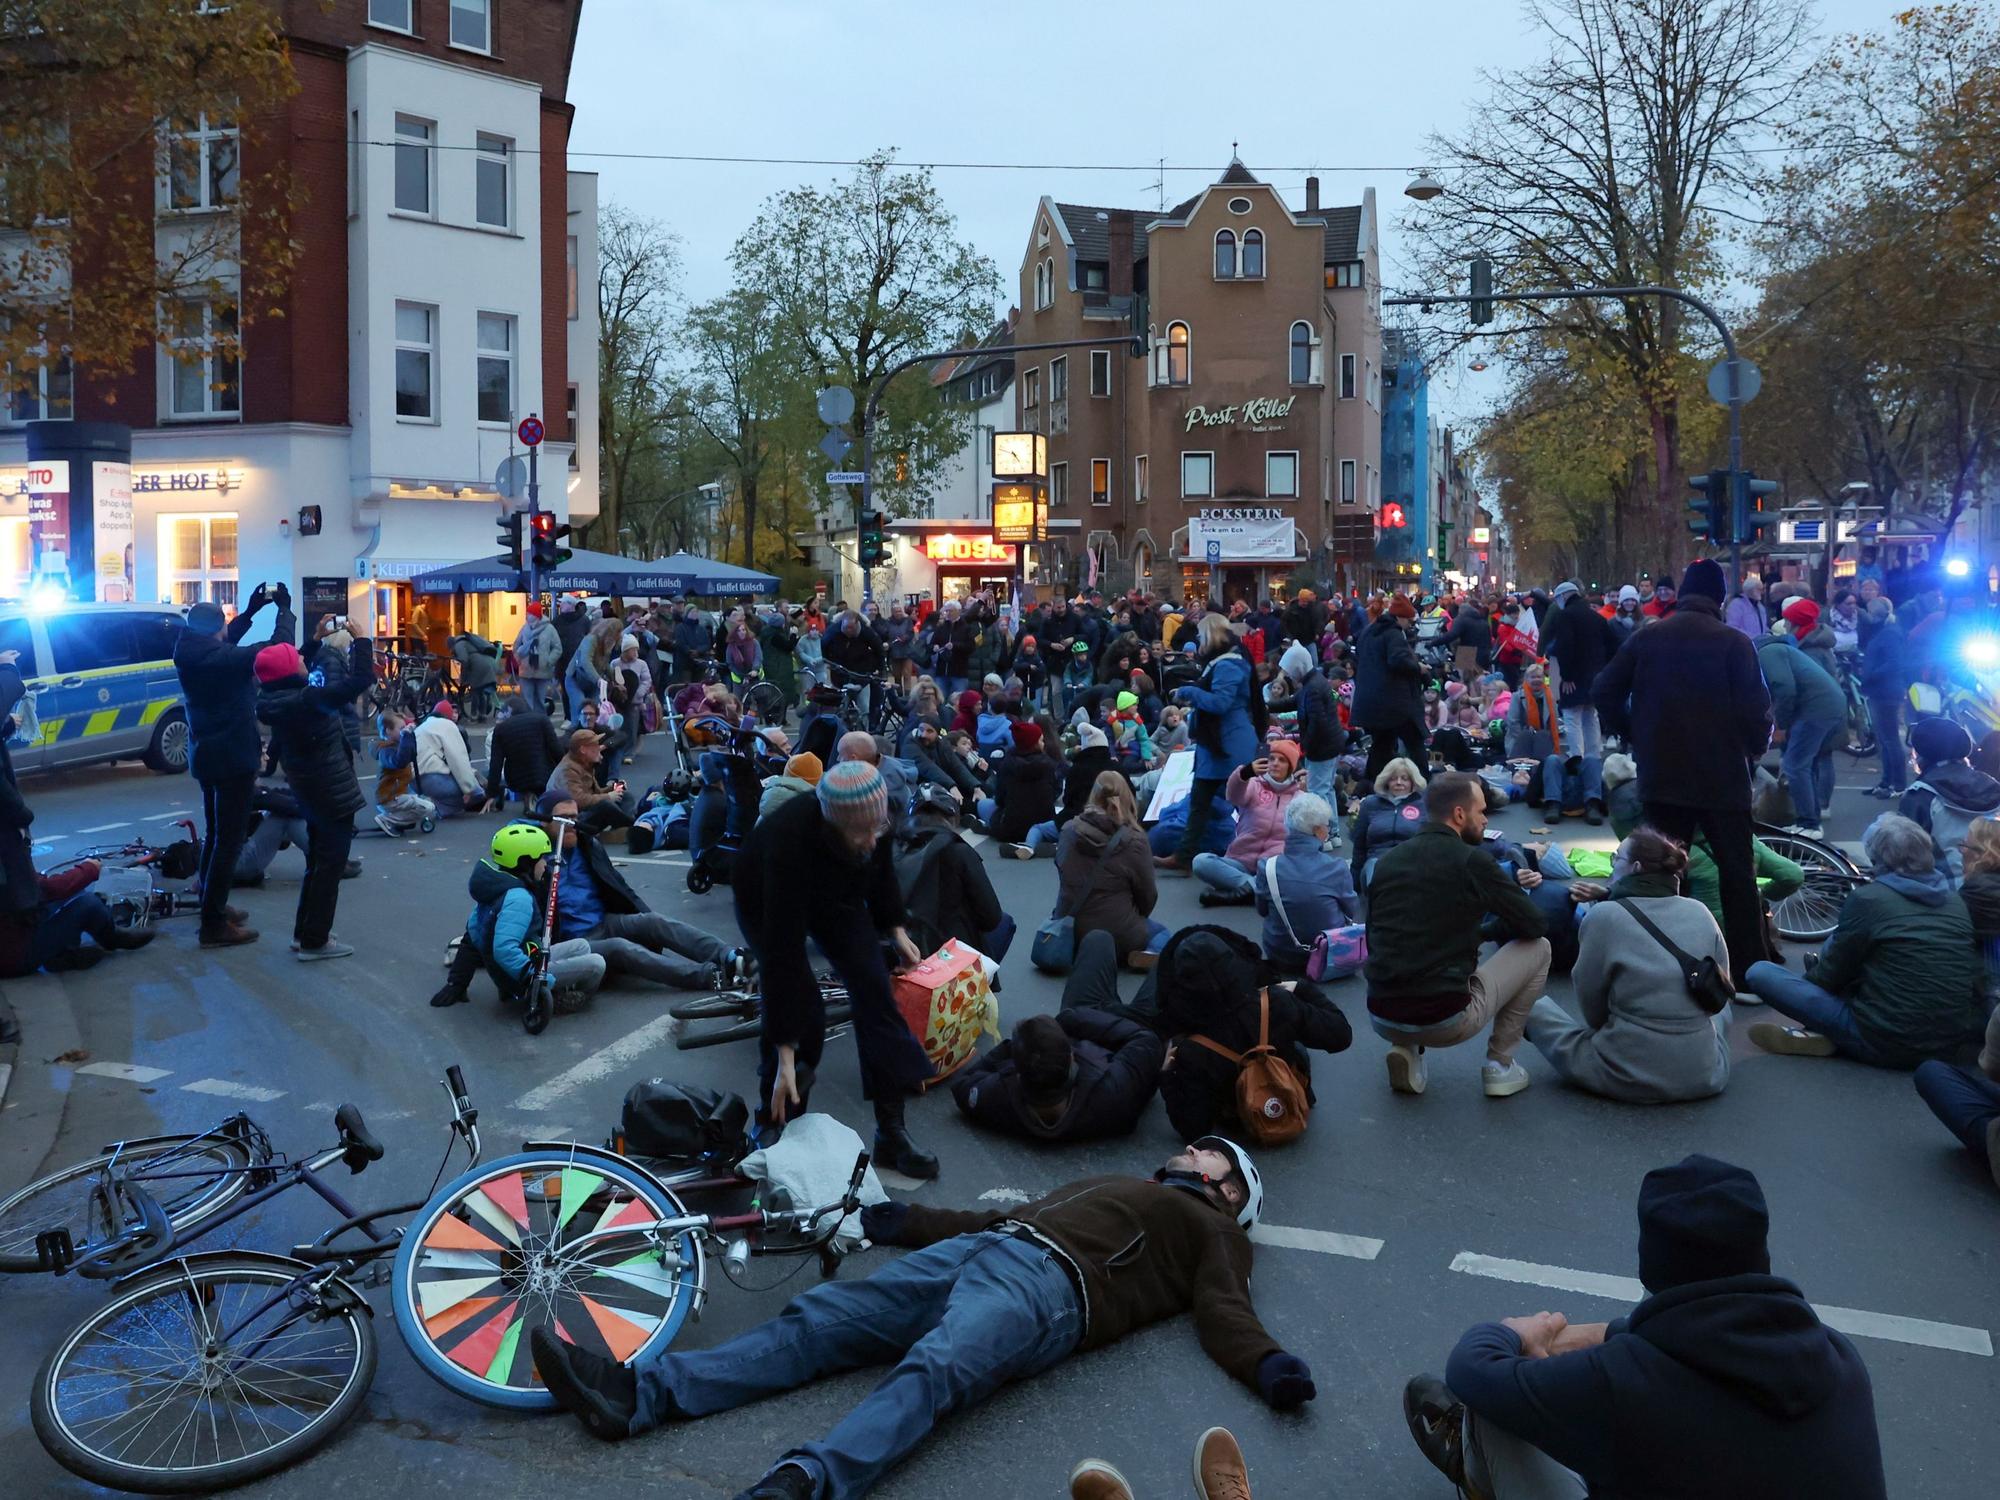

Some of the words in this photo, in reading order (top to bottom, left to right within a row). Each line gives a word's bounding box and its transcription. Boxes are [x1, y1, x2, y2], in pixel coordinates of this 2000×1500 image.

[1242, 395, 1296, 424] Kölle!
[170, 473, 209, 490] HOF
[828, 473, 862, 482] Gottesweg
[1200, 508, 1282, 520] ECKSTEIN
[927, 540, 1009, 559] KIOSK
[549, 577, 571, 588] Gaffel
[572, 577, 599, 589] Kölsch
[636, 577, 657, 588] Gaffel
[657, 577, 681, 589] Kölsch
[716, 582, 738, 592] Gaffel
[739, 582, 764, 592] Kölsch
